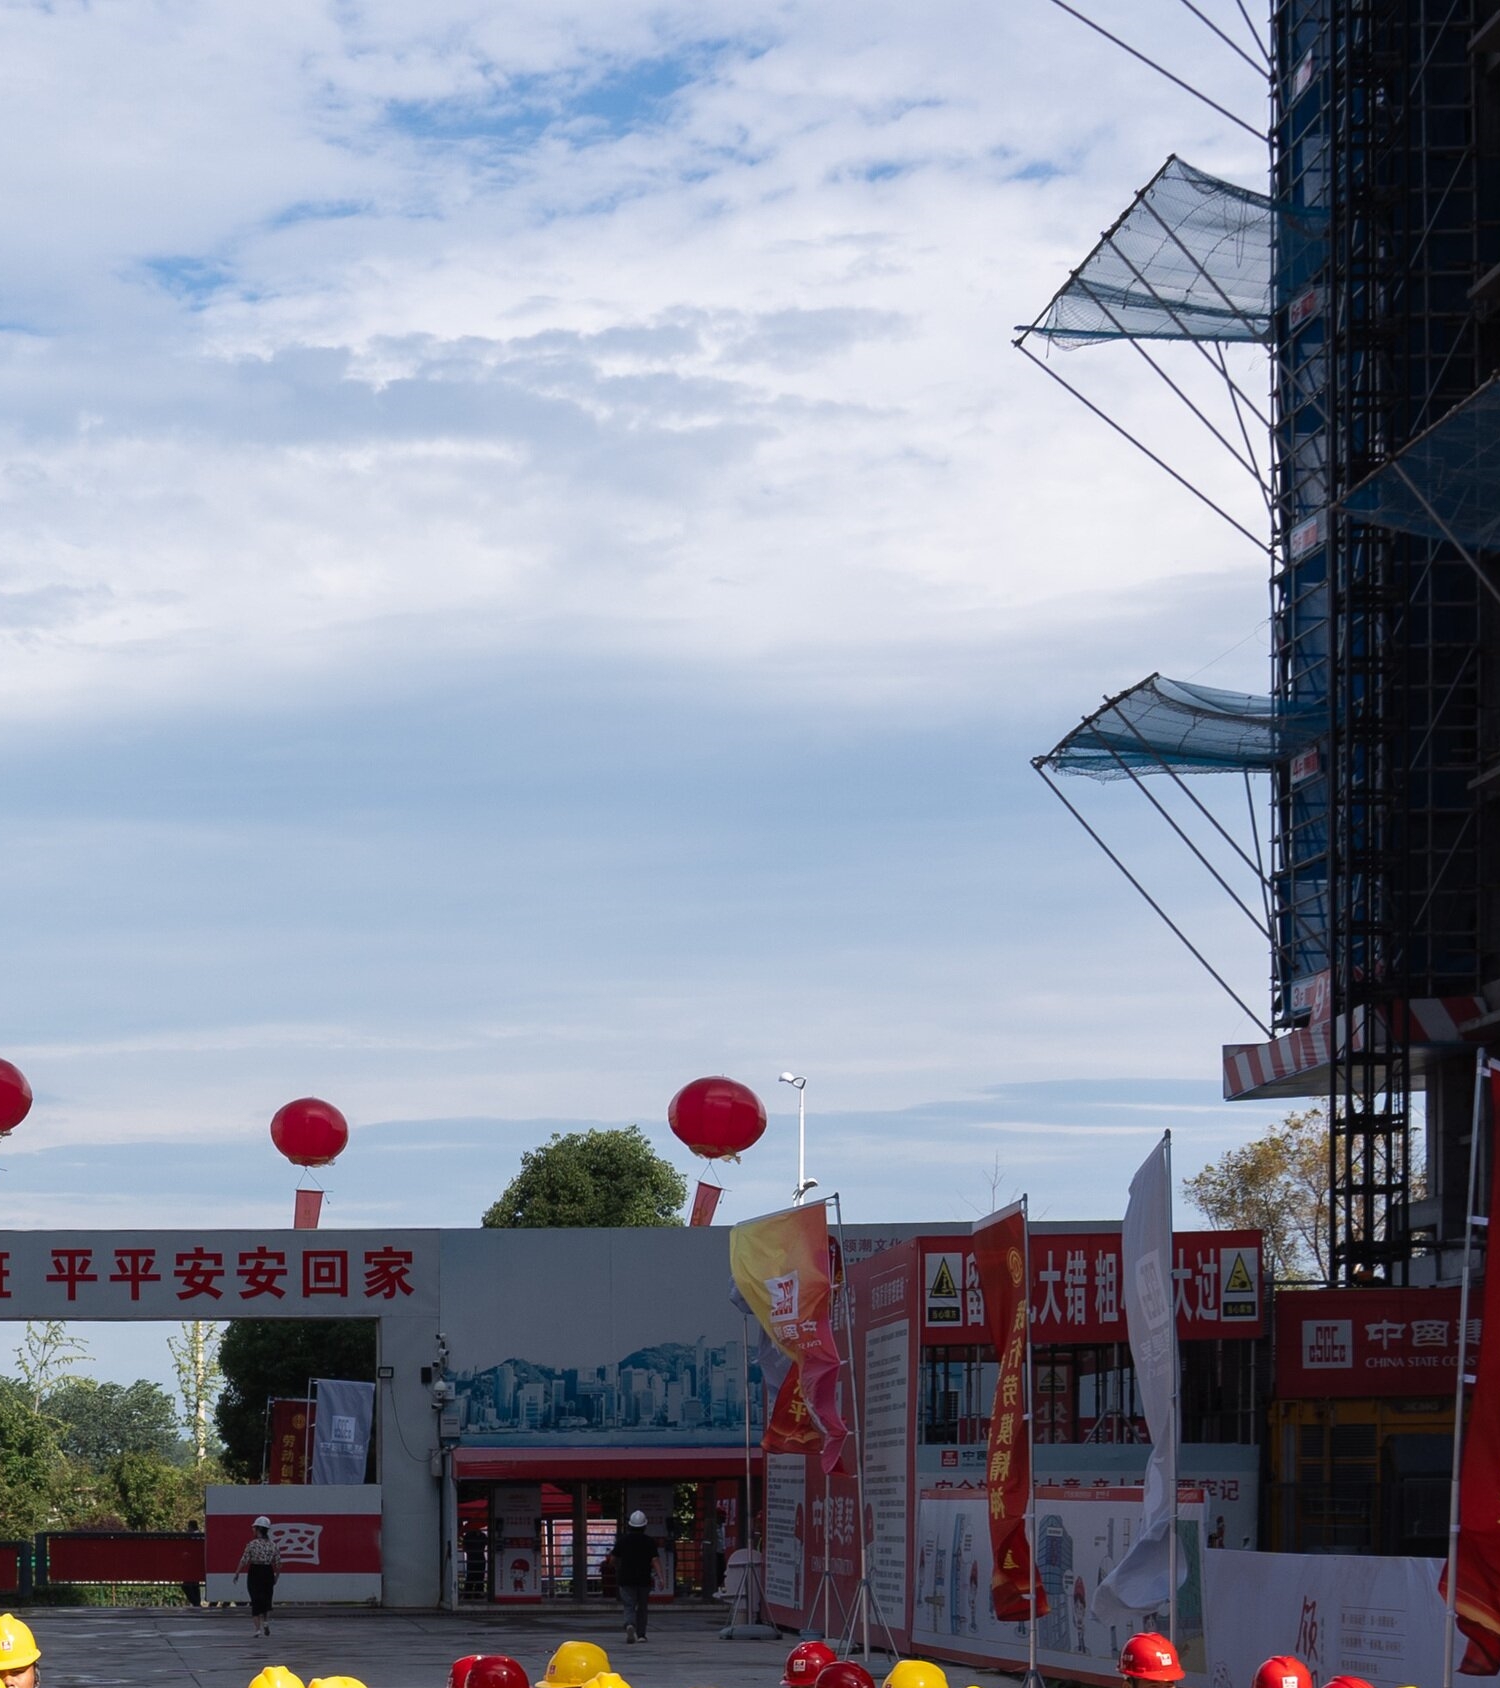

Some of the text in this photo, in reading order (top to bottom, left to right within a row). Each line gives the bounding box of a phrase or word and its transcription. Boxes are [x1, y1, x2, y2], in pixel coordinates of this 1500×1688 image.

[45, 1244, 415, 1302] 平平安安回家
[1364, 1355, 1405, 1369] CHINA
